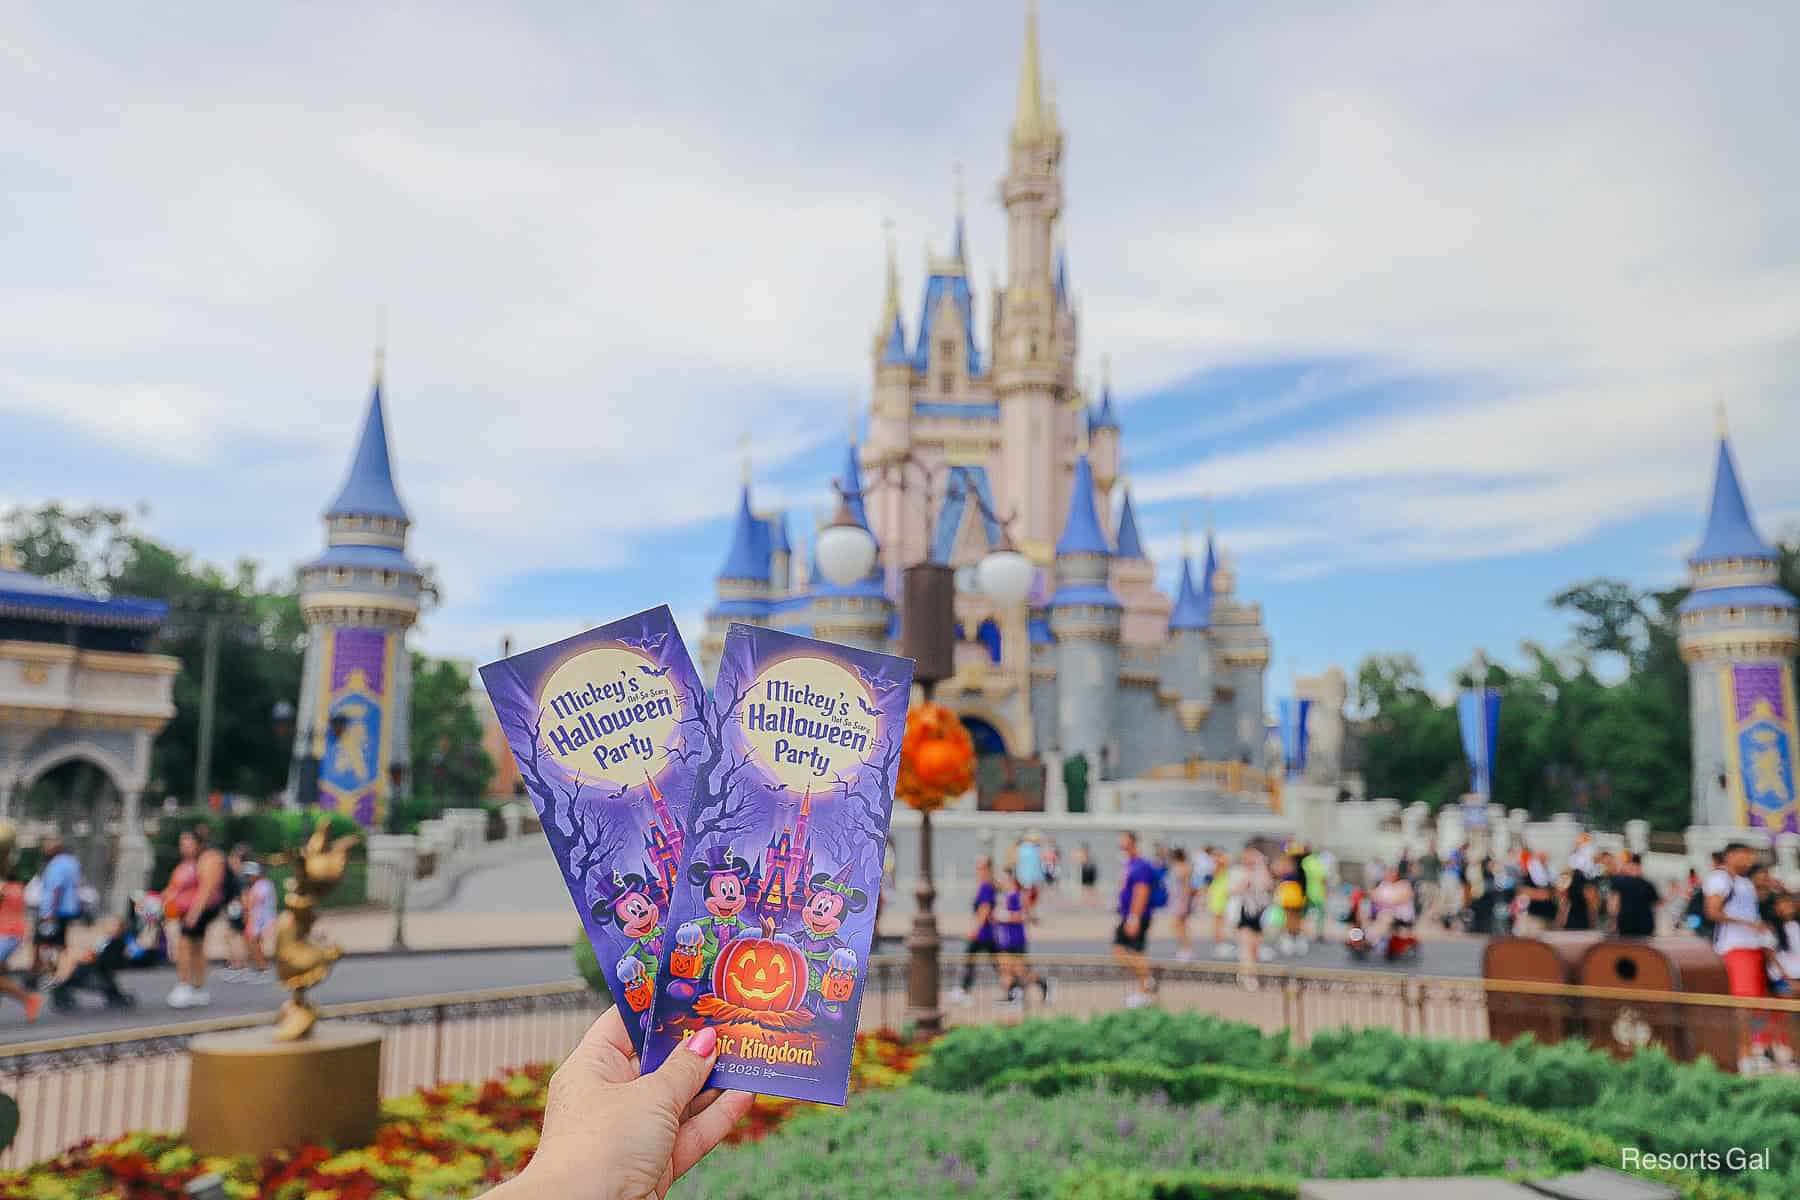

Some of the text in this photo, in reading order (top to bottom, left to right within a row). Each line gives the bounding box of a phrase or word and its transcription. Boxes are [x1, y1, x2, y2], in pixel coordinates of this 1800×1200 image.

[550, 670, 639, 719] Mickey's
[766, 679, 849, 717] Mickey's
[548, 696, 673, 757] Halloween
[748, 703, 867, 752] Halloween
[592, 733, 654, 770] Party
[775, 738, 830, 777] Party
[728, 1063, 760, 1076] 2025
